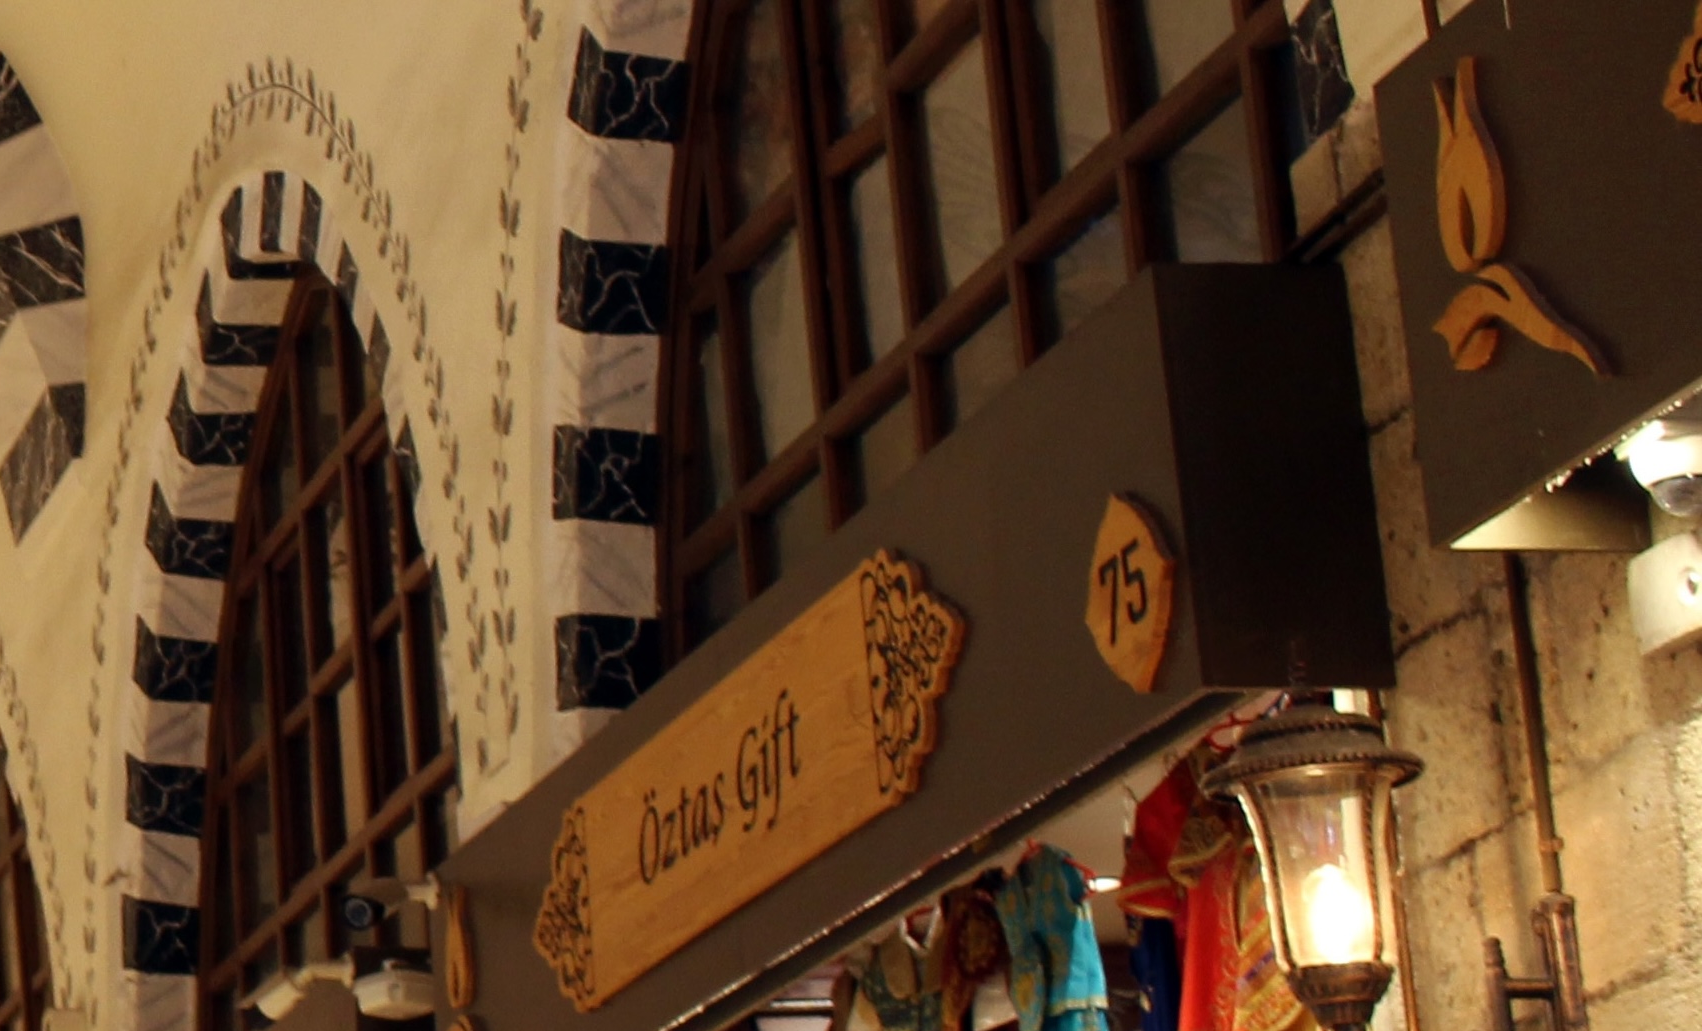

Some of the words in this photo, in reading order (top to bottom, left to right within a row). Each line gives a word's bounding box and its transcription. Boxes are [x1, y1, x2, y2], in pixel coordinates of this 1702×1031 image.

[1099, 537, 1148, 648] 75
[639, 771, 725, 886] Öztaş
[736, 689, 801, 832] Gift
